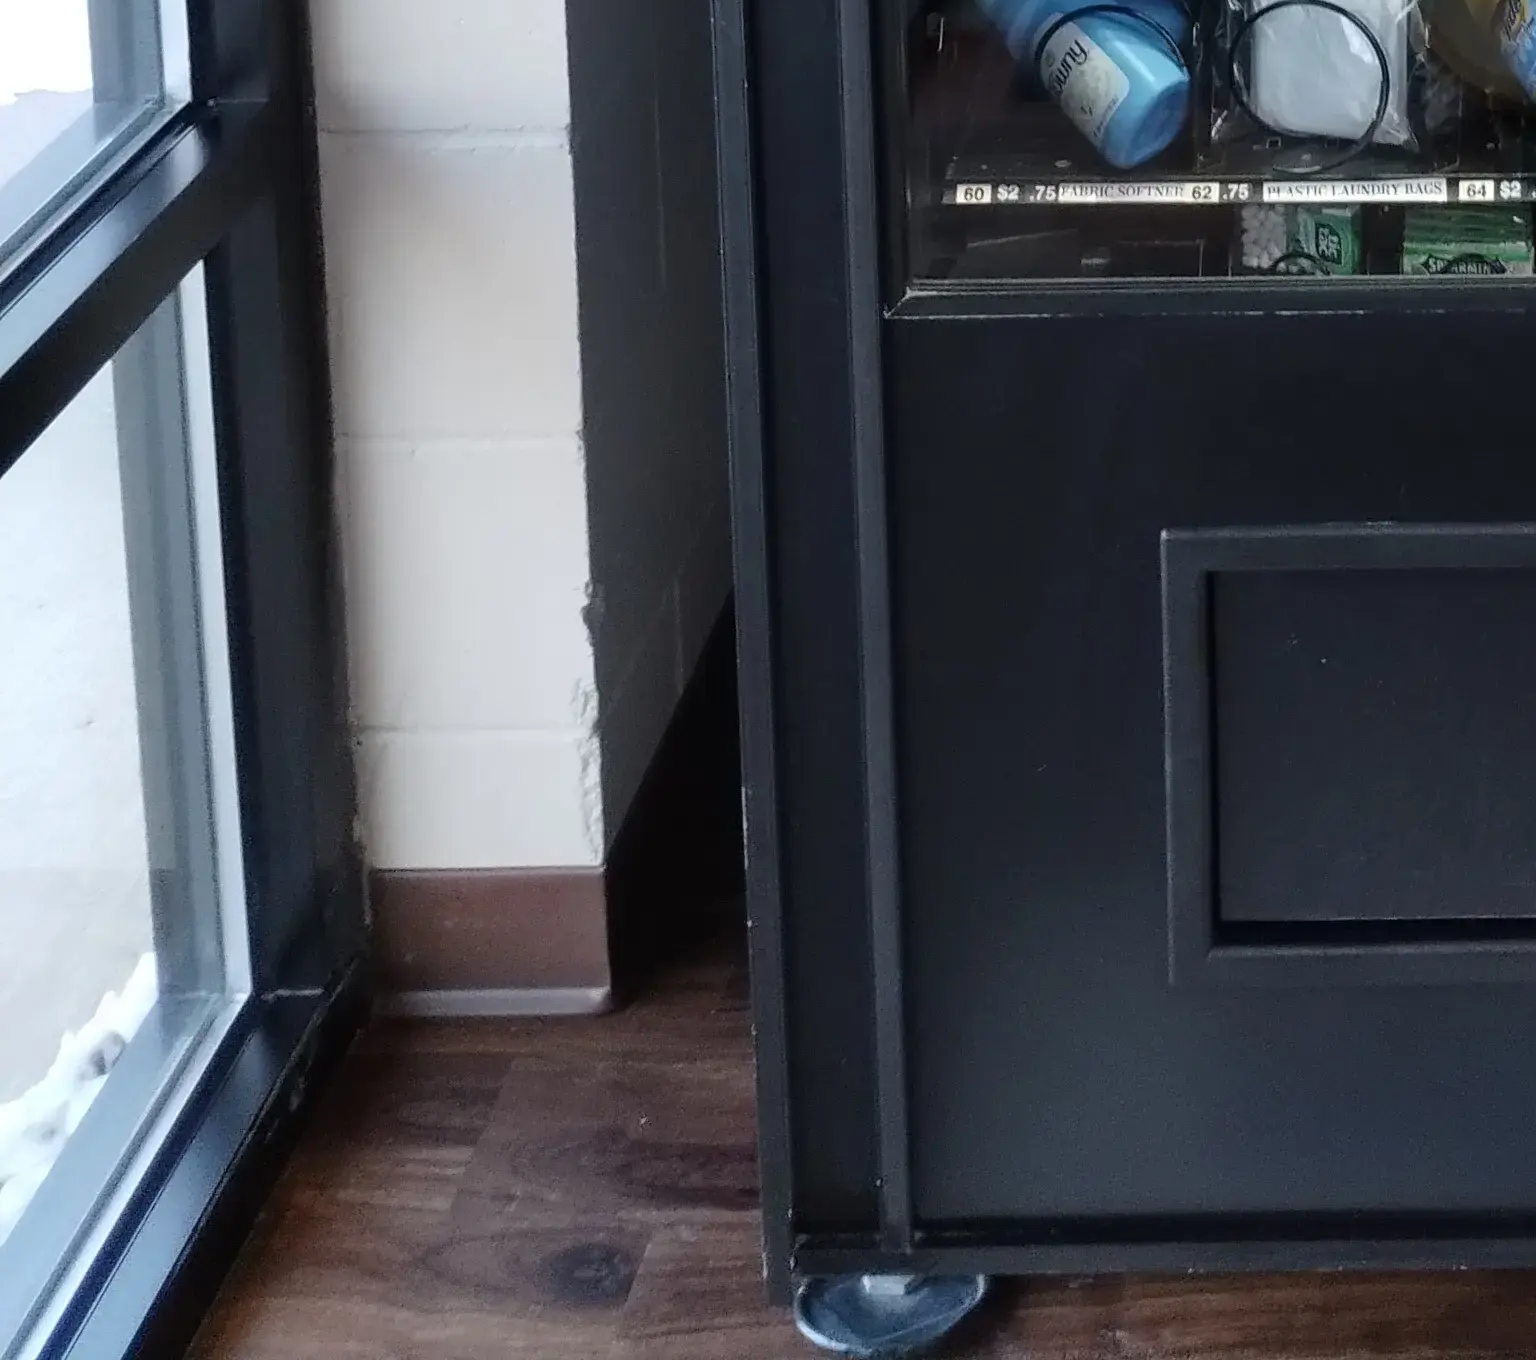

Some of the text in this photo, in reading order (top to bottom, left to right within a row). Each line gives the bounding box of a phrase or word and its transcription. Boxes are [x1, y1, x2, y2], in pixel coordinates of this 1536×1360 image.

[963, 187, 985, 201] 60
[1061, 185, 1115, 199] FABRIC
[1191, 186, 1213, 200] 62
[1329, 182, 1399, 197] LAUNDRY
[1404, 180, 1444, 194] BAGS
[1466, 184, 1487, 198] 64
